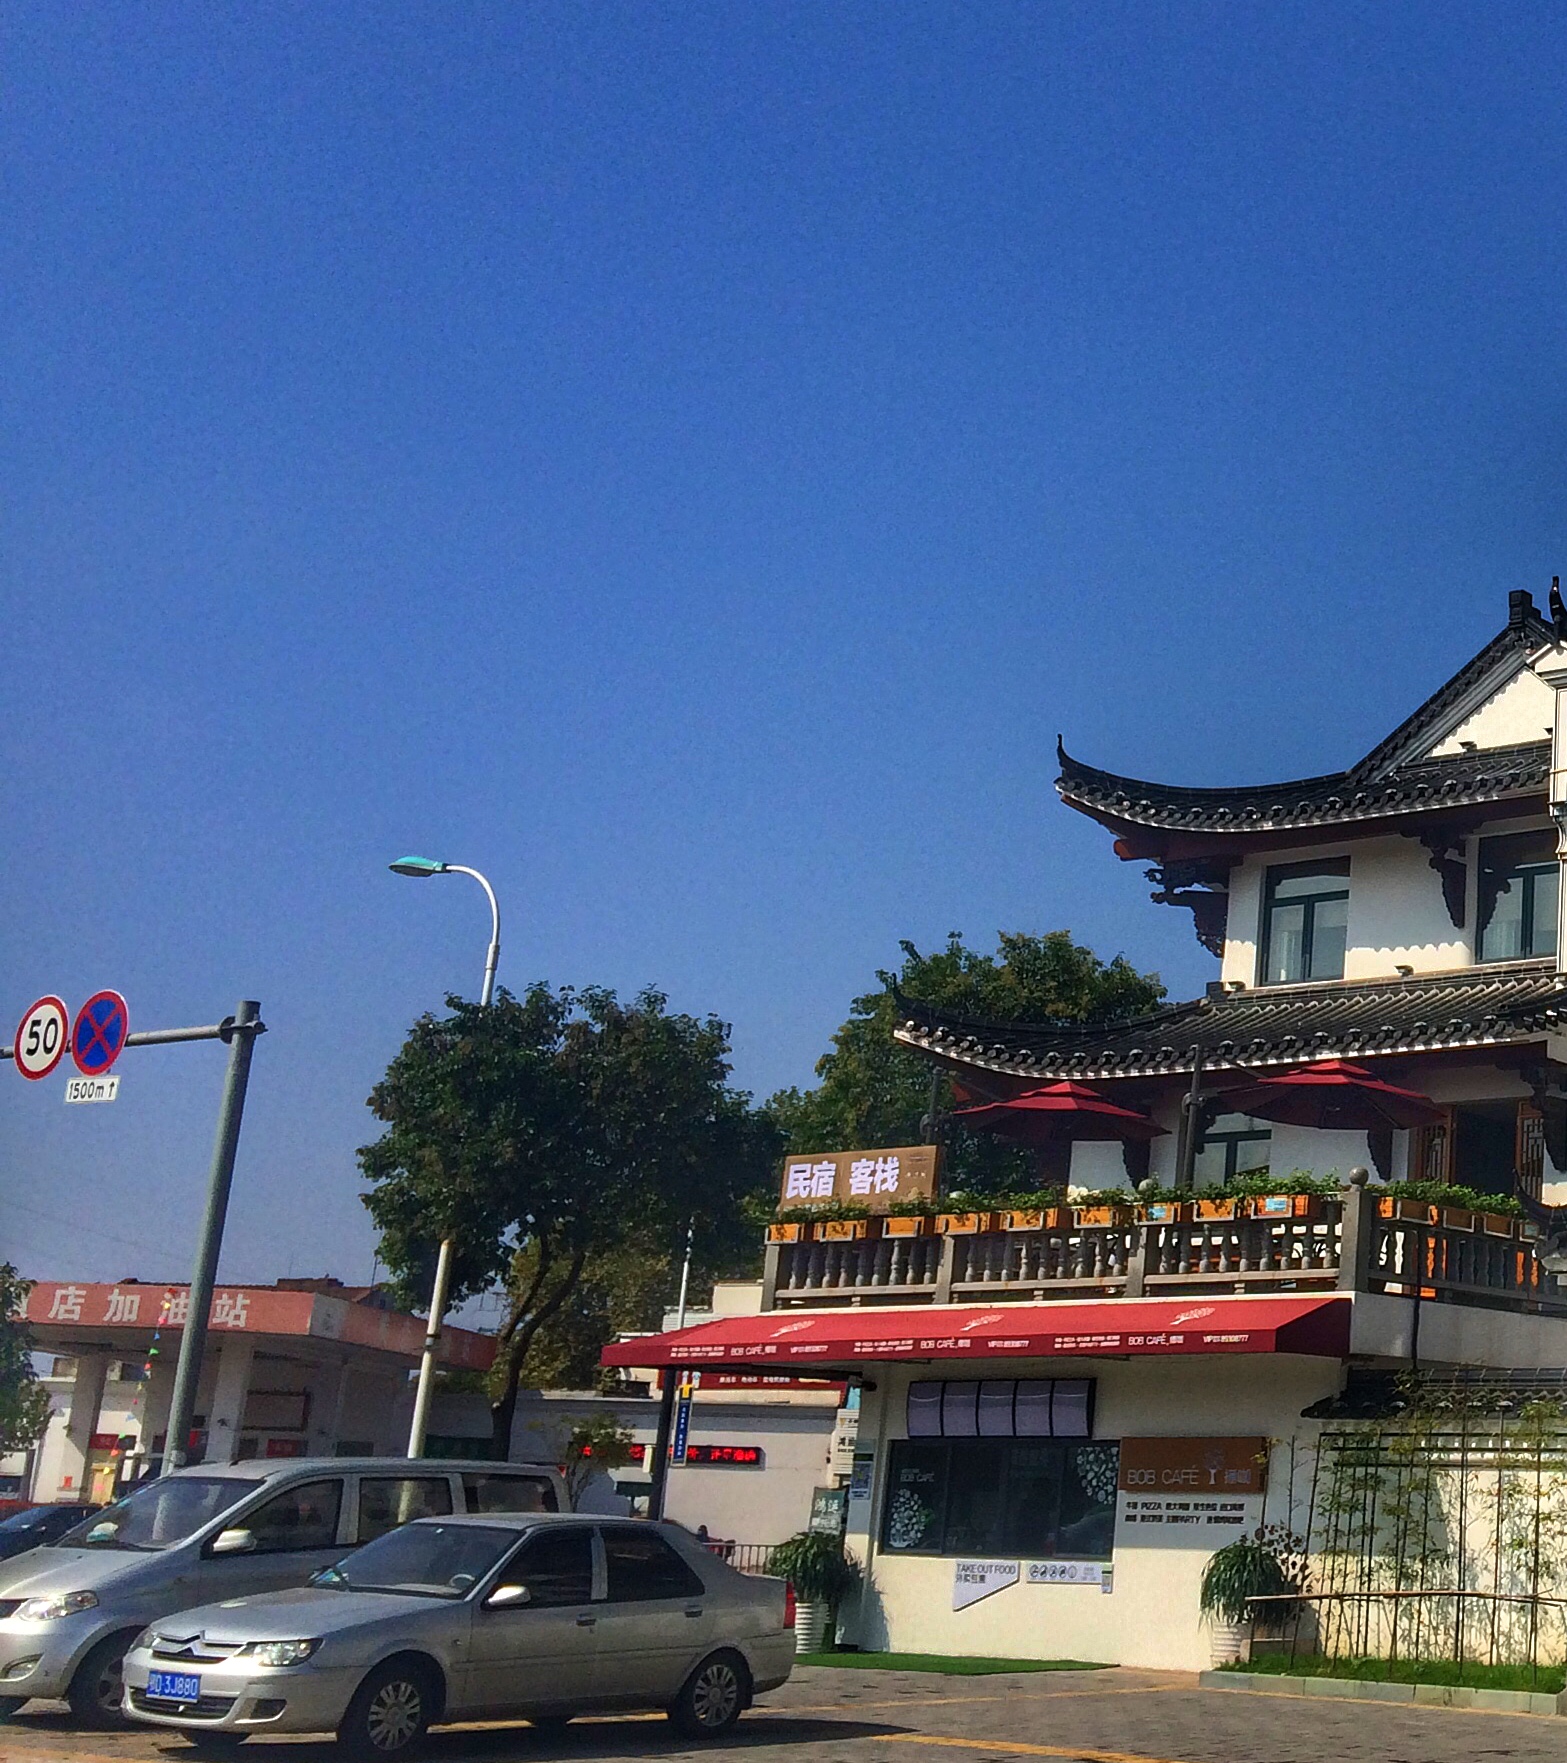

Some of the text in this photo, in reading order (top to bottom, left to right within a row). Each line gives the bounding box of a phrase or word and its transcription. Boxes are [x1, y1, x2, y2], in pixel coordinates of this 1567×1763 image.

[25, 1017, 59, 1057] 50
[68, 1081, 105, 1100] 1500m
[786, 1160, 837, 1199] 民宿
[849, 1156, 900, 1196] 客栈
[920, 1340, 935, 1349] BOB
[1128, 1336, 1144, 1346] BOB
[1127, 1469, 1156, 1485] BOB
[1161, 1464, 1200, 1485] CAFÉ
[1140, 1501, 1162, 1511] PIZZA
[956, 1563, 1017, 1575] TAKE OUT FOOD
